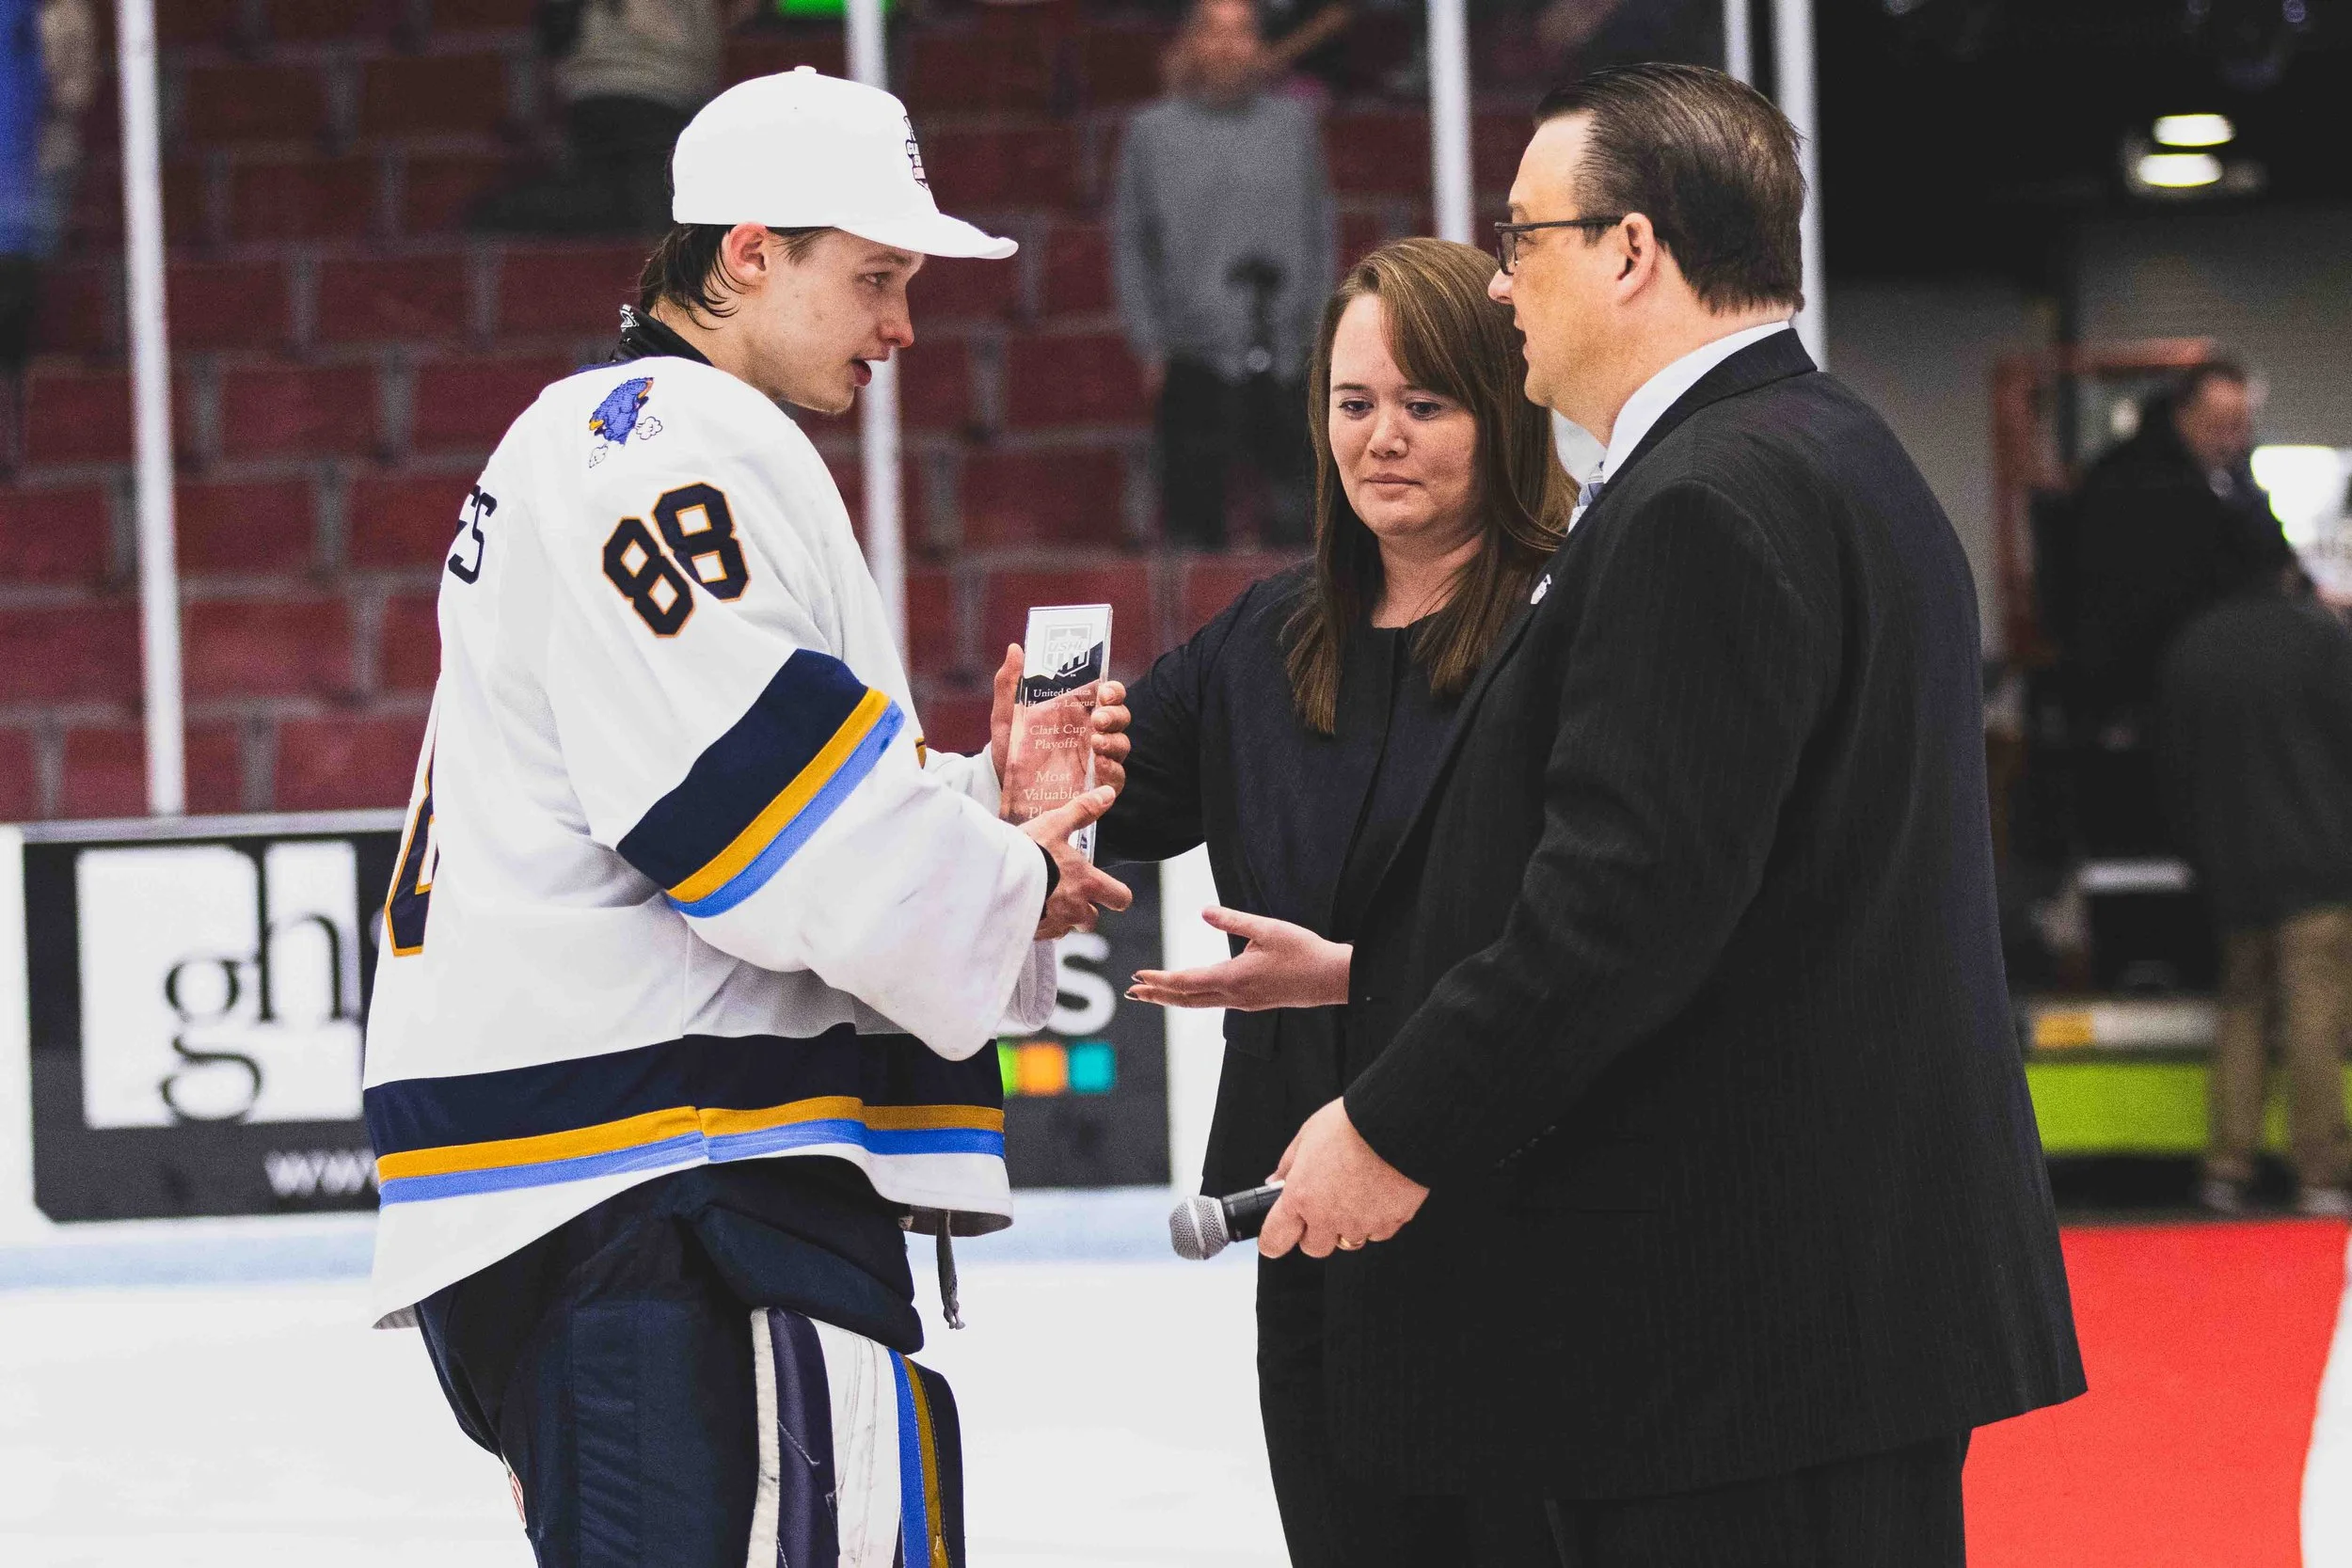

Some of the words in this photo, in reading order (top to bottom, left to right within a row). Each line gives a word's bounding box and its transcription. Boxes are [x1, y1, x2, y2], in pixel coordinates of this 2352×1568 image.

[602, 482, 750, 639] 88
[1033, 688, 1064, 698] United
[1029, 723, 1060, 736] Clark
[1062, 723, 1087, 736] Cup
[1034, 736, 1078, 752] Playoffs
[1034, 770, 1071, 783] Most
[1023, 786, 1080, 801] Valuable
